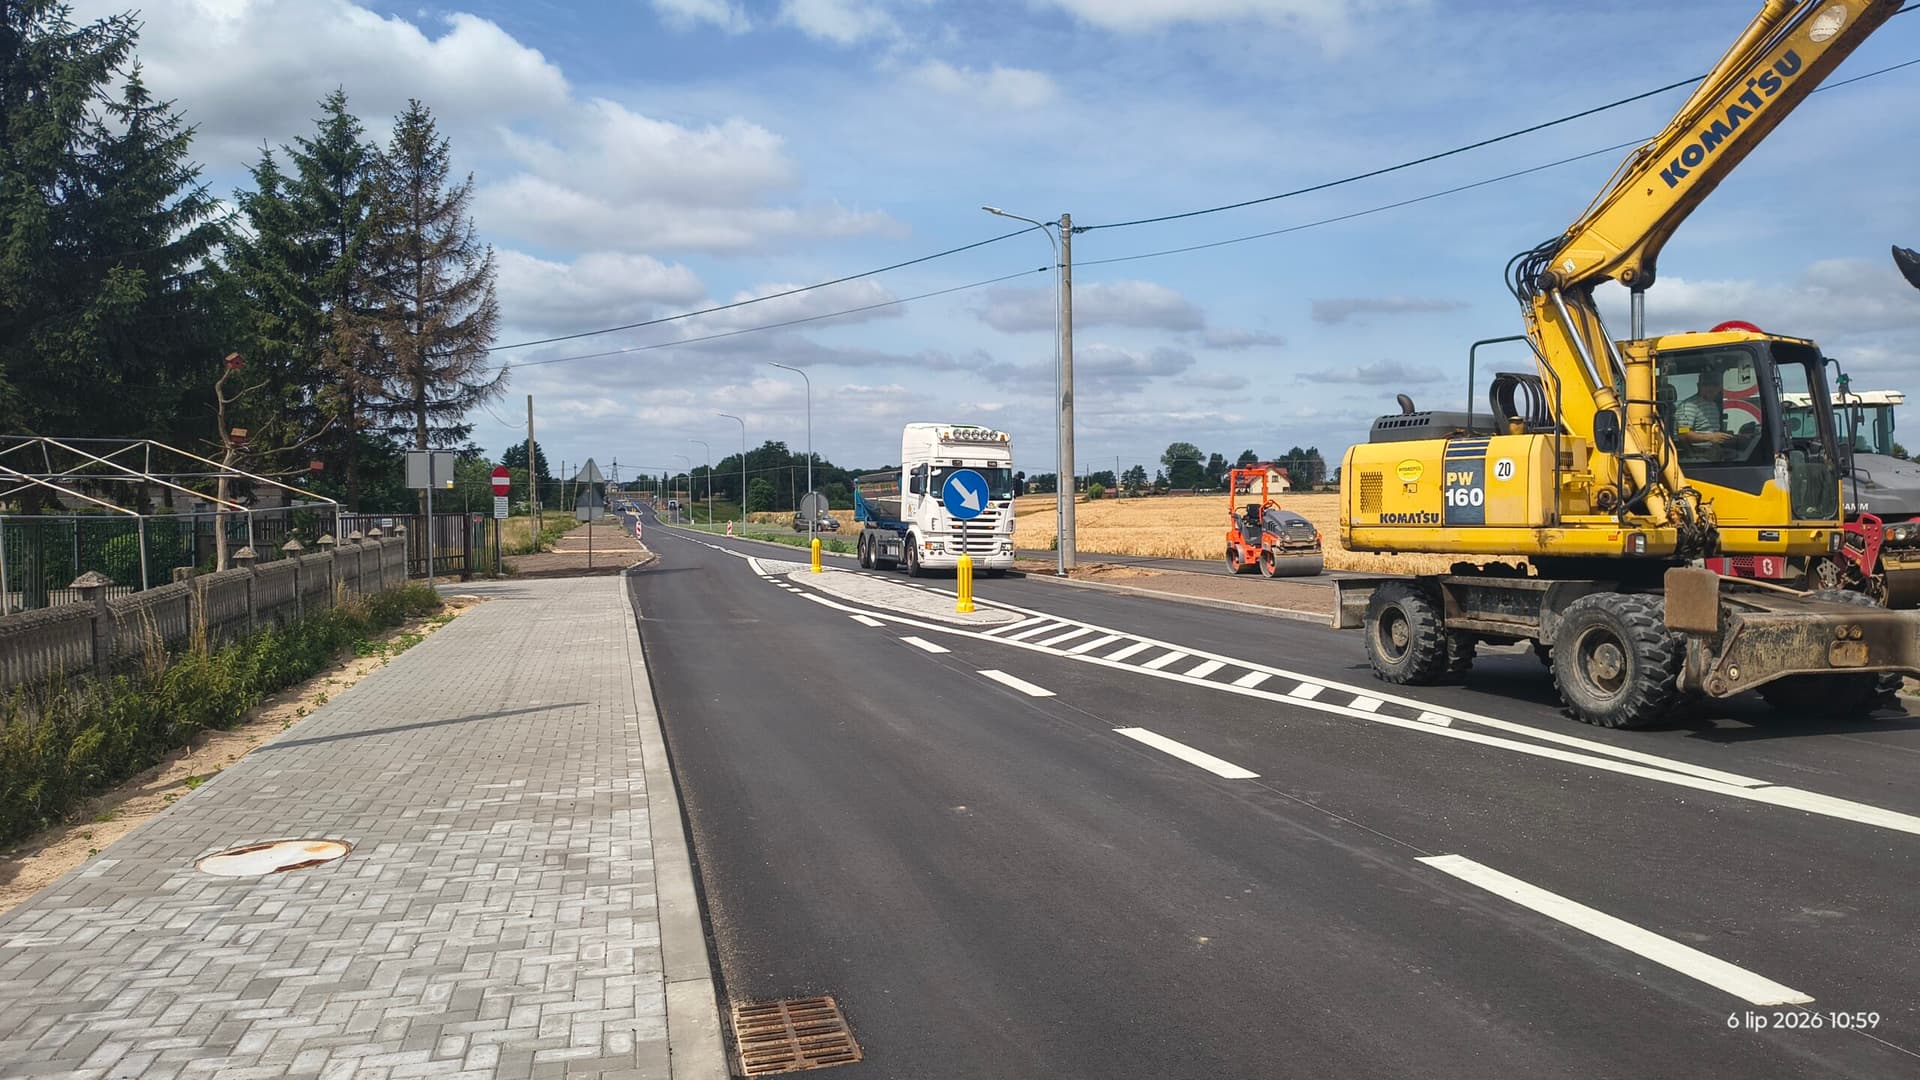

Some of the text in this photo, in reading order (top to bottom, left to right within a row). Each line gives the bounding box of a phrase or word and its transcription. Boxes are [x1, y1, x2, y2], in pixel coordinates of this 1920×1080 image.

[1659, 49, 1802, 189] KOMATSU
[1498, 462, 1511, 477] 20
[1446, 471, 1474, 486] PW
[1445, 488, 1484, 507] 160
[1842, 503, 1869, 511] AMM
[1380, 510, 1440, 524] KOMATSU
